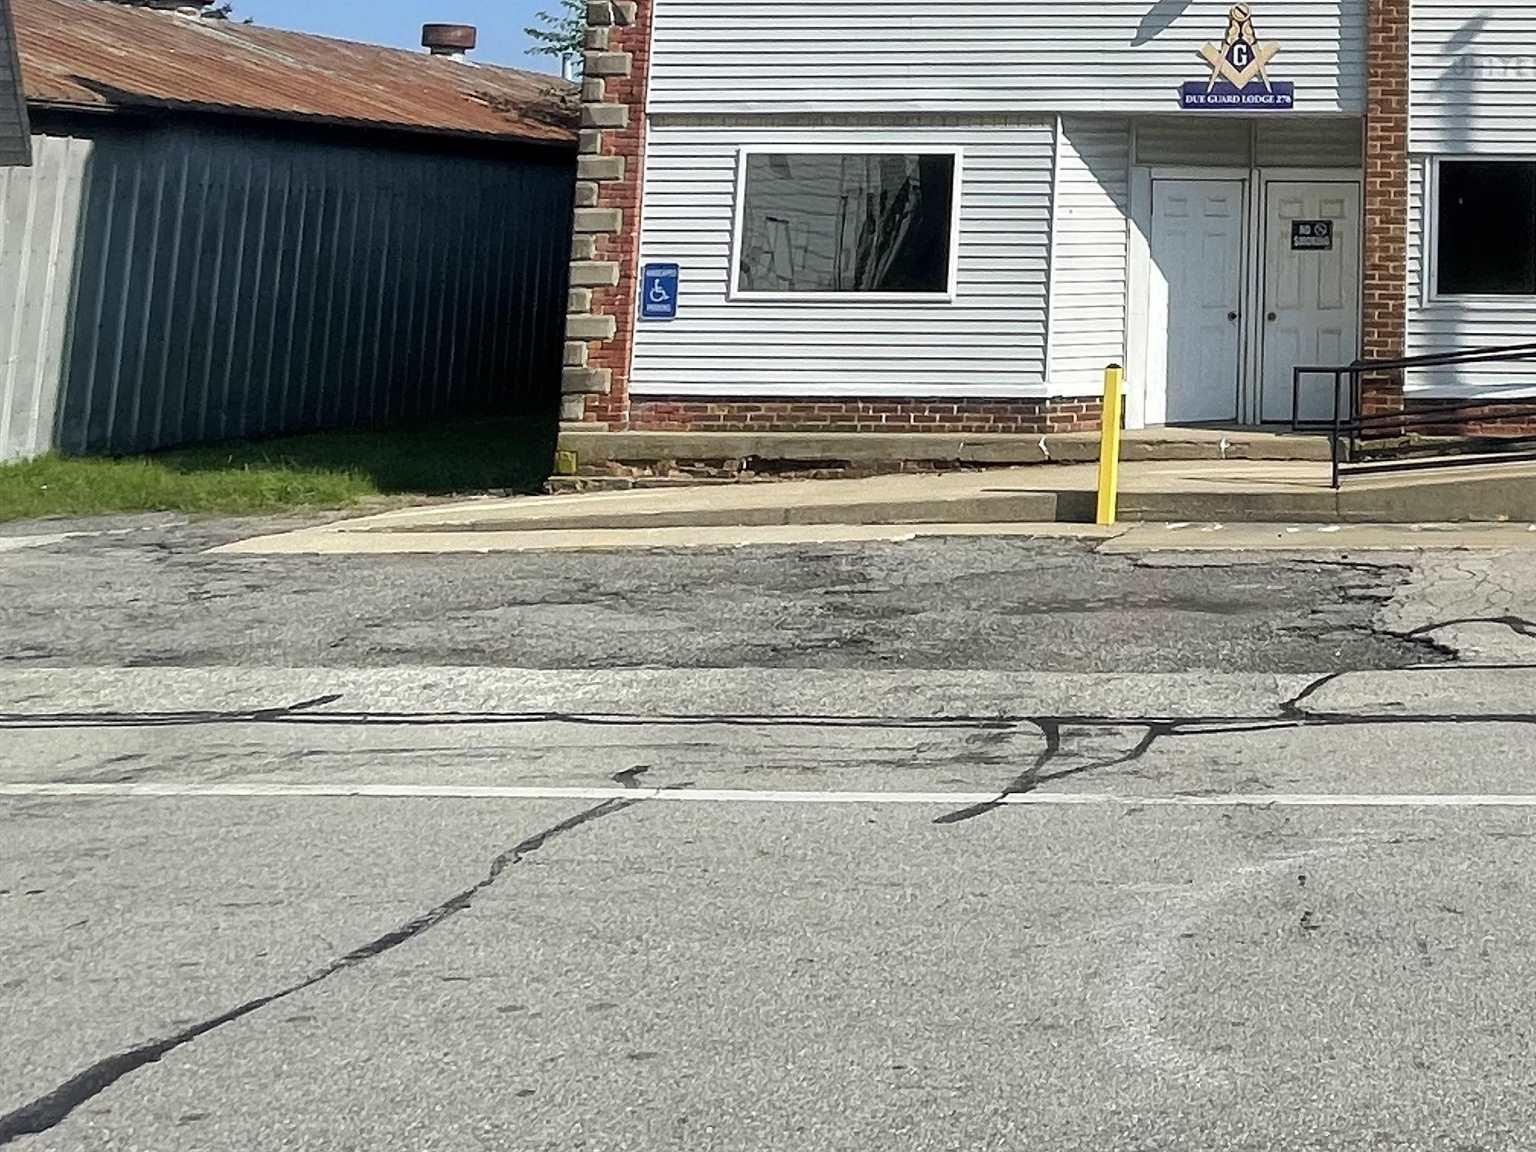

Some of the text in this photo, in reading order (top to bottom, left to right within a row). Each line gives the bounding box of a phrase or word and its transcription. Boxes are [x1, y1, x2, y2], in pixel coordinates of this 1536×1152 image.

[1233, 44, 1247, 65] G
[1185, 94, 1205, 103] DUE
[1207, 94, 1240, 103] GUARD
[1242, 94, 1274, 103] LODGE
